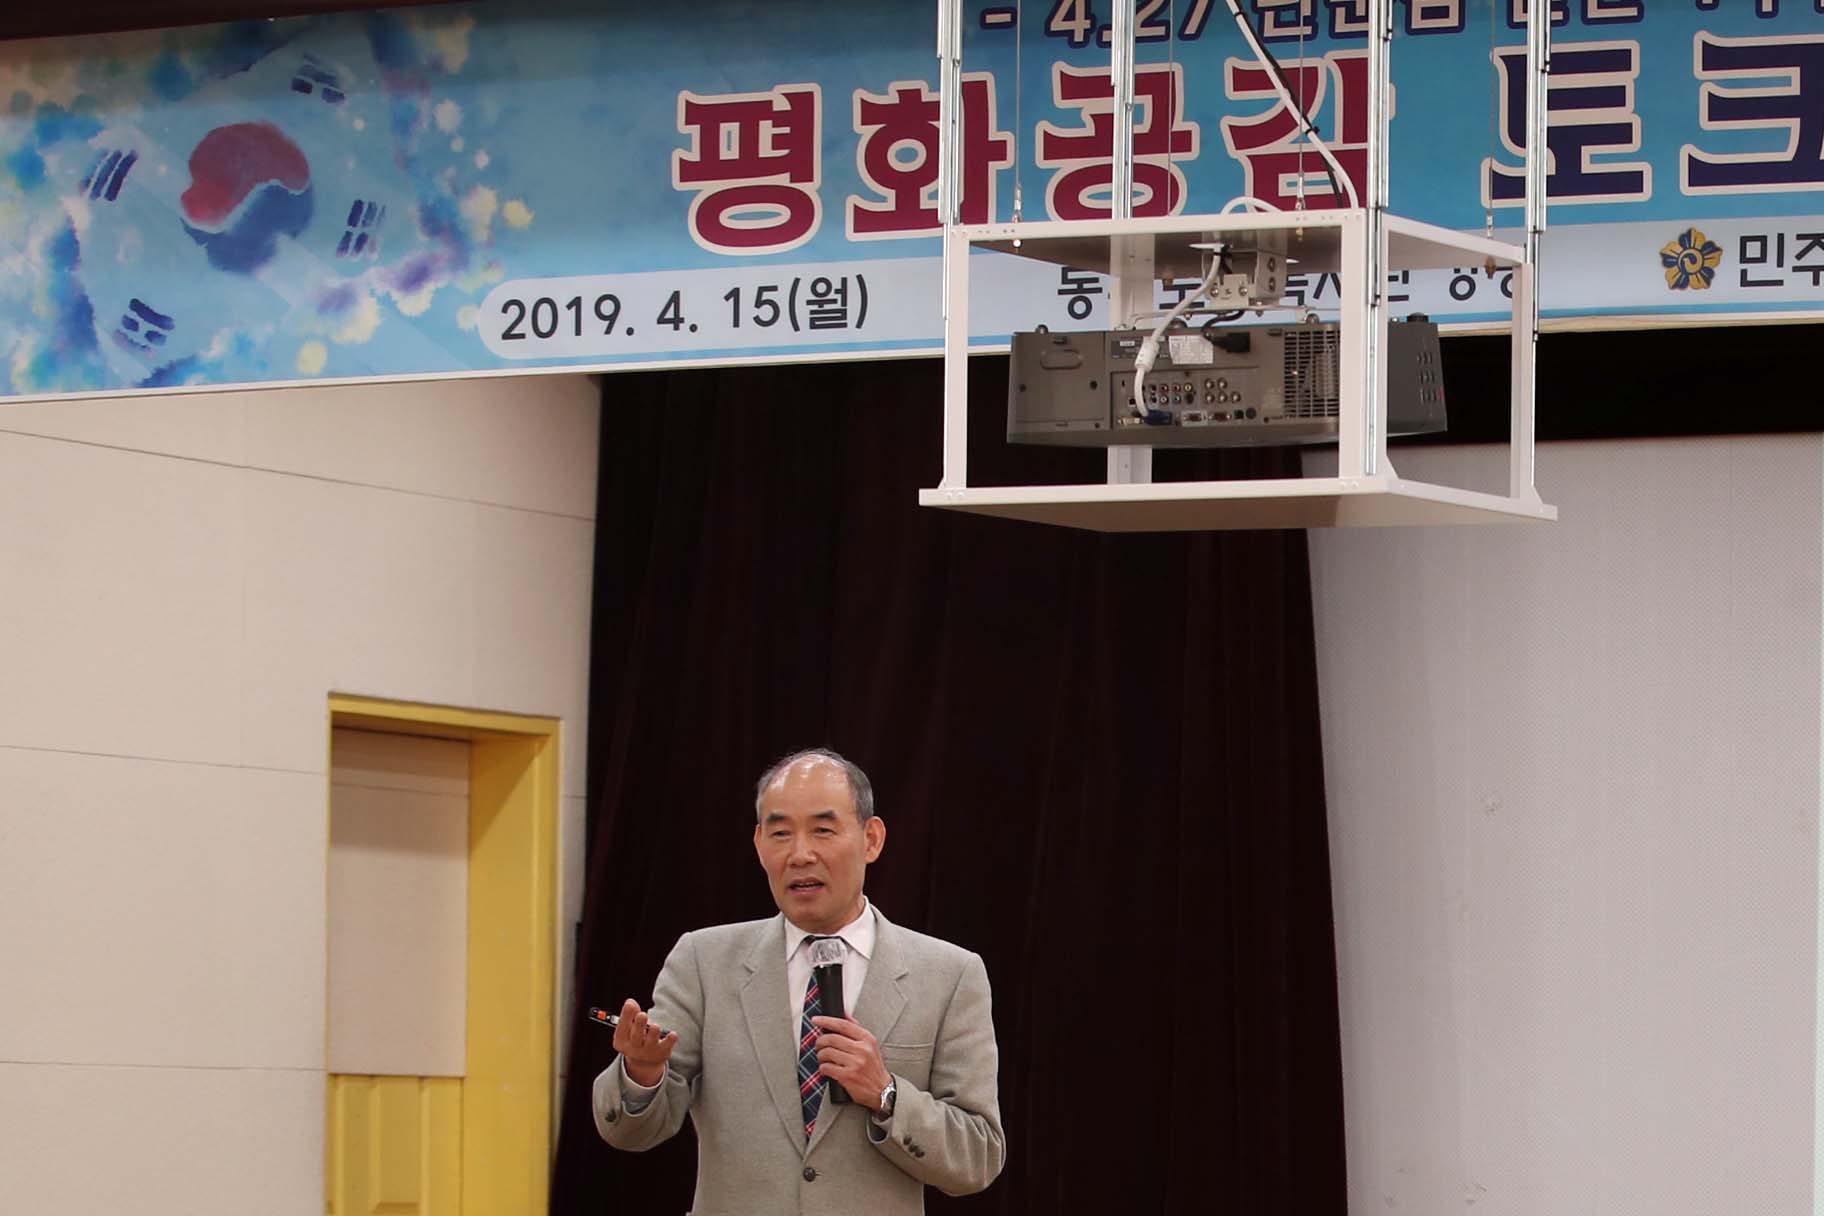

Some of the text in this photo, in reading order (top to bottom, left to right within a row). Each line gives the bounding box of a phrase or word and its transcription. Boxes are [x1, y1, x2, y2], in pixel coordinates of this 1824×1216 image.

[672, 54, 1394, 256] 평화공감
[501, 273, 869, 340] 2019. 4. 15(월)
